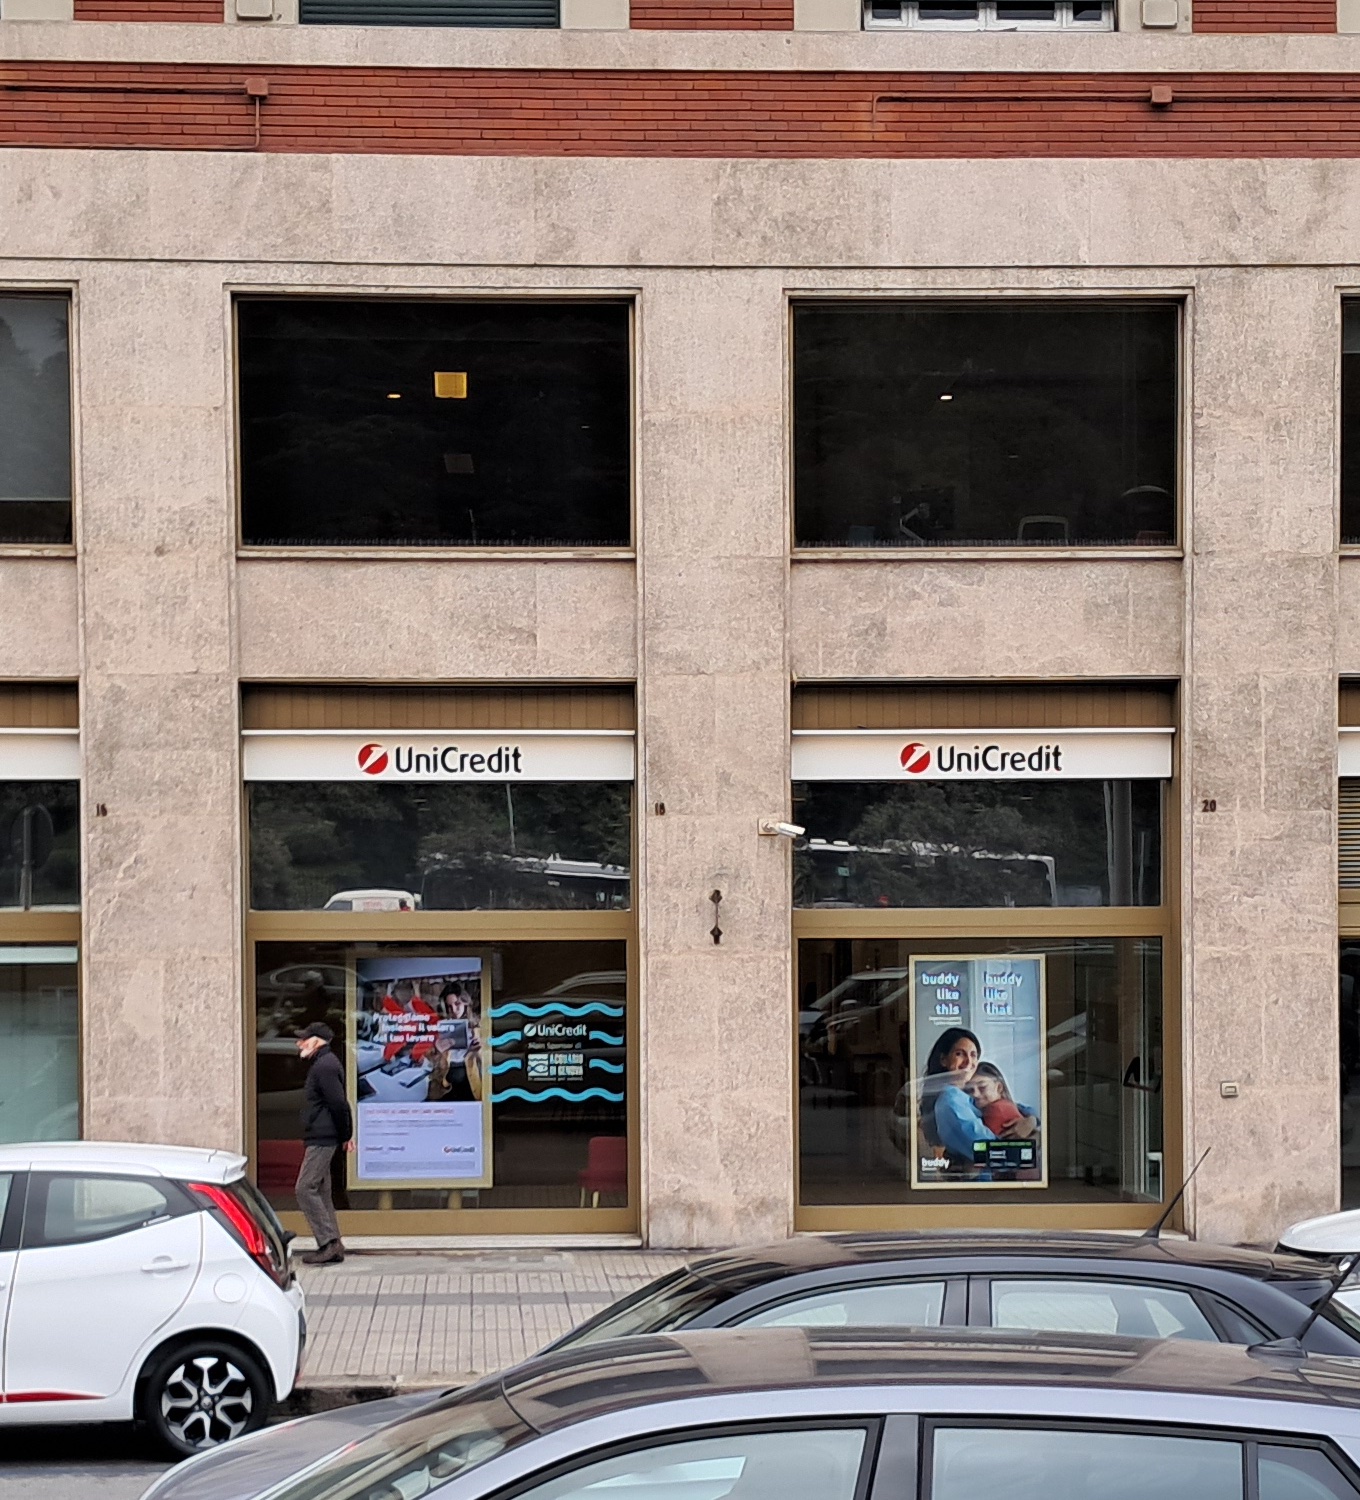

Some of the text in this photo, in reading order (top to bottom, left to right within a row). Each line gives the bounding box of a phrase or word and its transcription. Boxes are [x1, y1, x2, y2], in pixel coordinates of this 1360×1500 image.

[395, 746, 522, 773] UniCredit
[937, 745, 1062, 772] UniCredit
[1201, 799, 1217, 813] 20
[921, 973, 960, 987] buddy
[984, 972, 1023, 987] buddy
[936, 988, 960, 1000] like
[984, 987, 1009, 1000] like
[935, 1003, 960, 1015] this
[984, 1003, 1013, 1015] that
[537, 1024, 588, 1037] UniCredit
